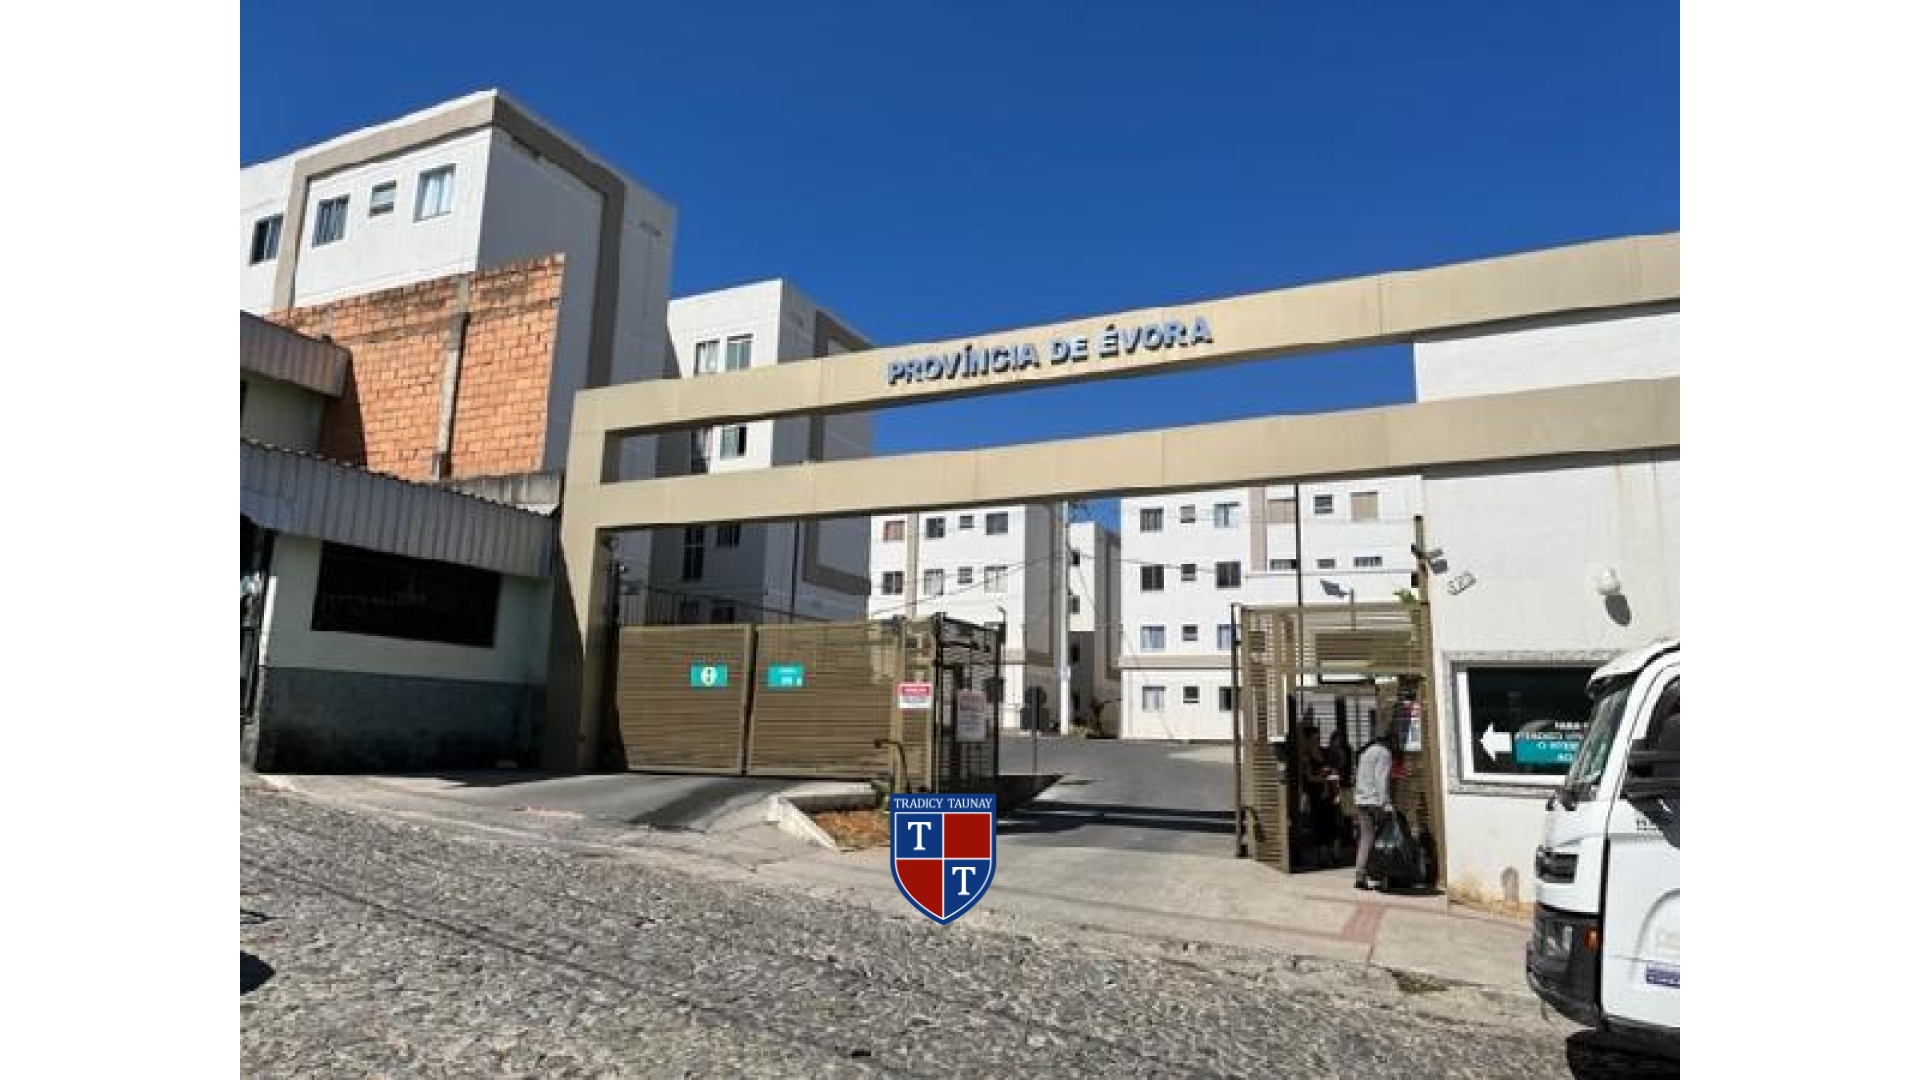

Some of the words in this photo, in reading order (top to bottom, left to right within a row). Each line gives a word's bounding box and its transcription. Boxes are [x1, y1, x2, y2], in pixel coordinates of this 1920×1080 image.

[887, 344, 1041, 386] PROVÍNCIA
[1049, 335, 1089, 366] DE
[1099, 316, 1214, 358] ÉVORA
